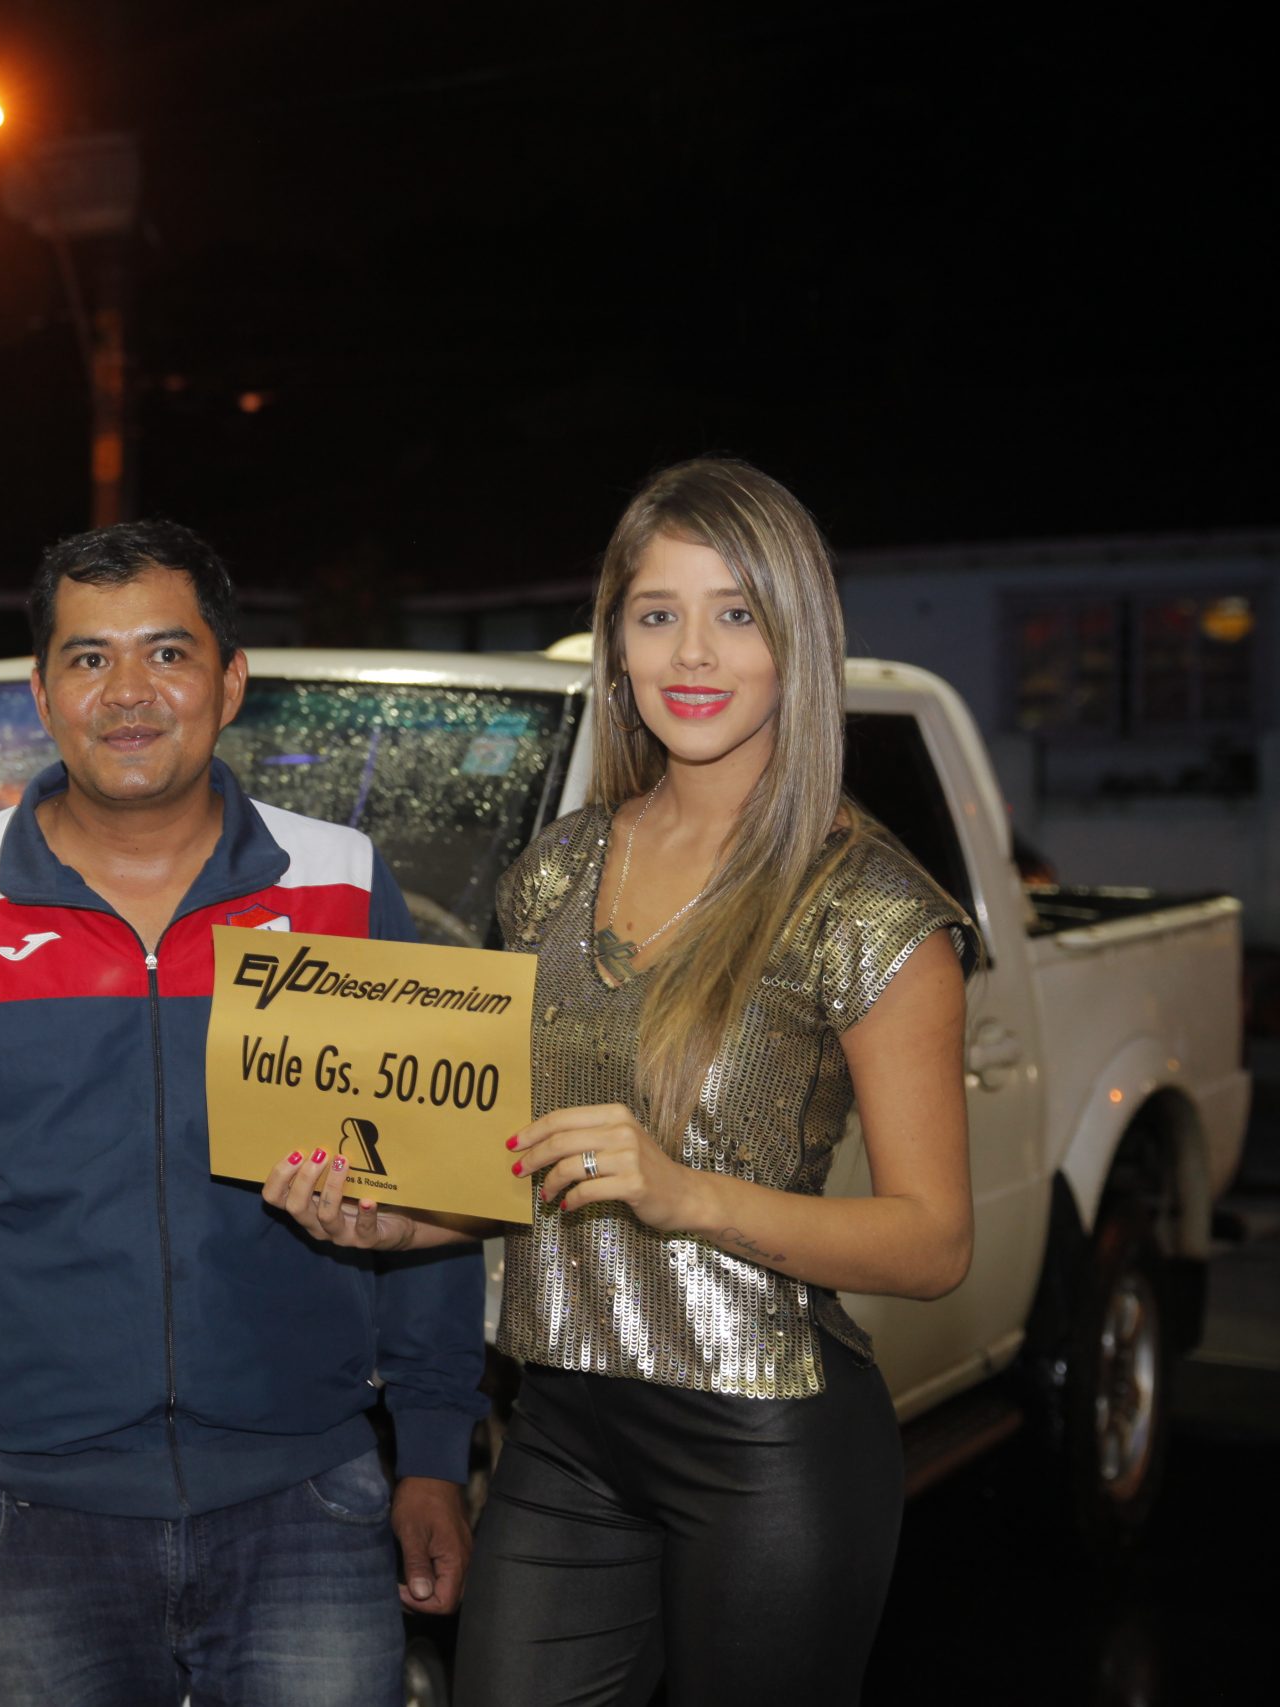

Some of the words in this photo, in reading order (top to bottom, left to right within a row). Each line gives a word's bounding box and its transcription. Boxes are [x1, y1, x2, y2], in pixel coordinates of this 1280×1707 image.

[233, 946, 329, 1010] EVO
[314, 972, 400, 1002] Diesel
[391, 979, 512, 1015] Premium
[242, 1034, 303, 1088] Vale
[315, 1044, 360, 1096] Gs.
[373, 1051, 500, 1112] 50.000
[365, 1177, 398, 1191] Rodados
